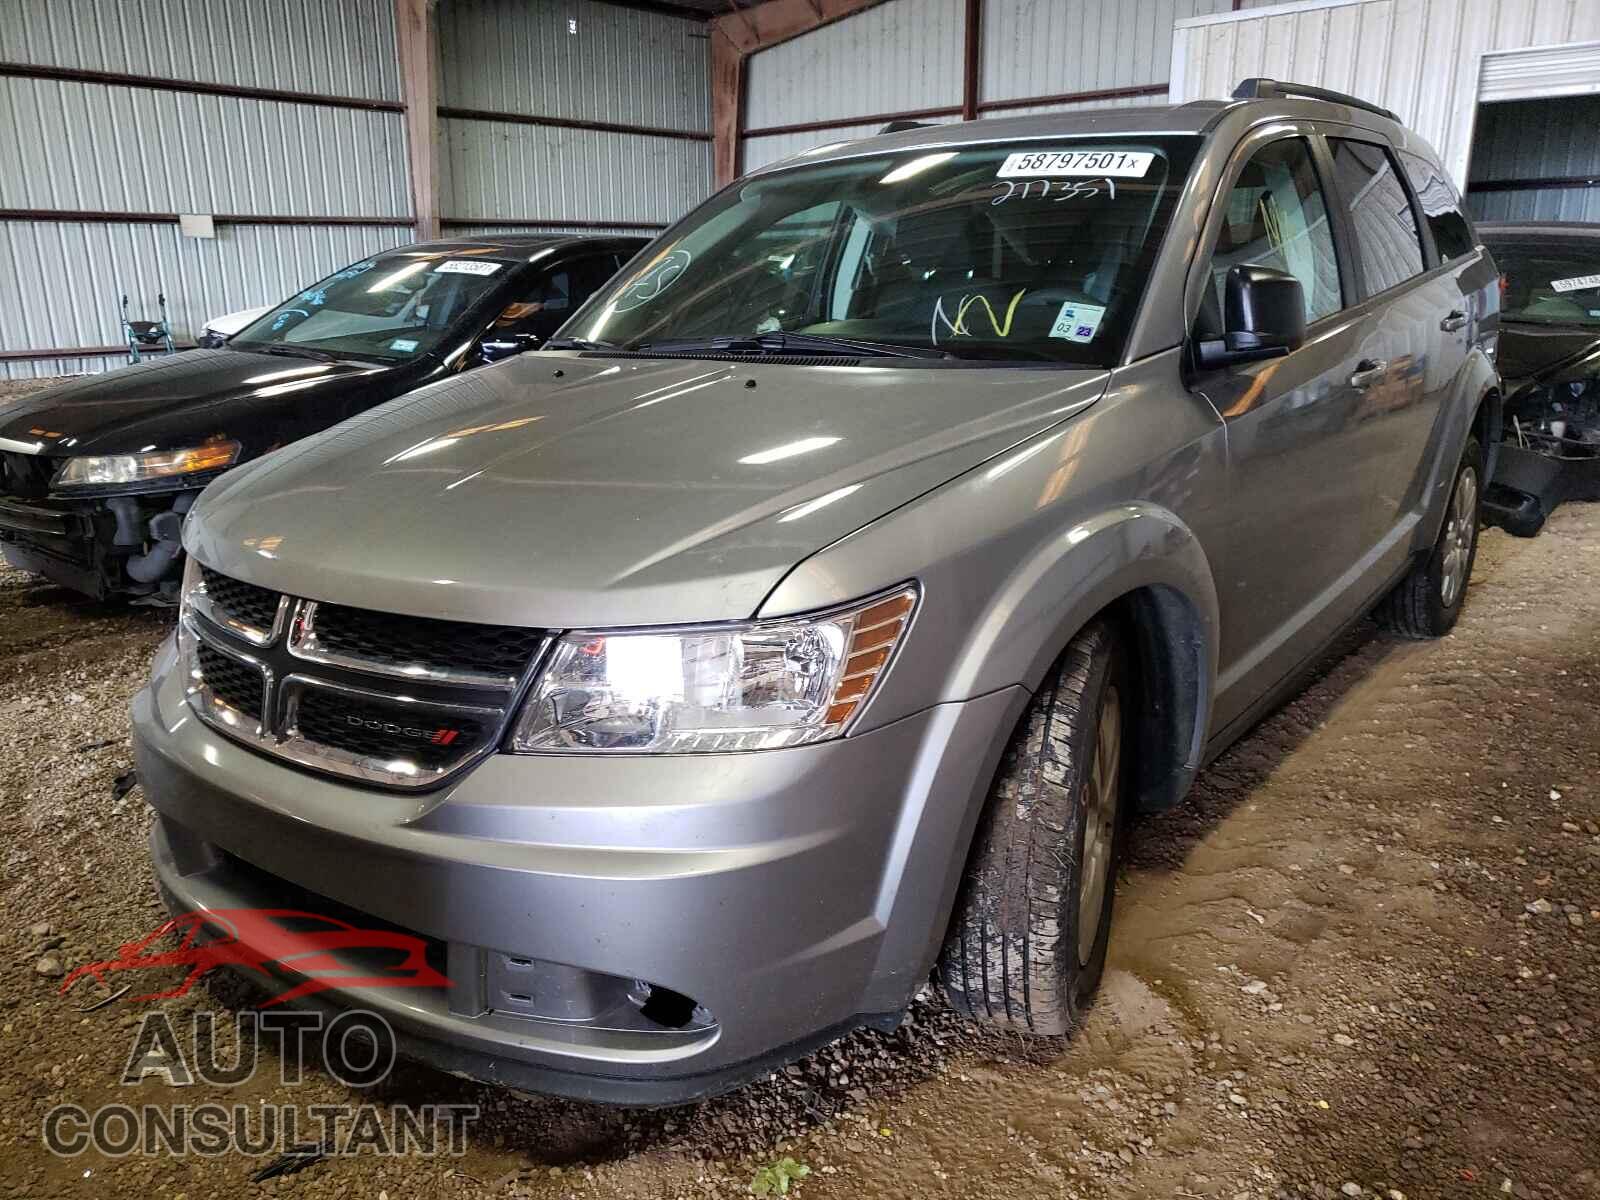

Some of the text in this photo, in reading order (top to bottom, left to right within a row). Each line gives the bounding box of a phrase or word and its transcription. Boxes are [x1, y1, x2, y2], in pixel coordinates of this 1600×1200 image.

[1056, 322, 1093, 337] 03 23
[346, 715, 440, 741] DODGE
